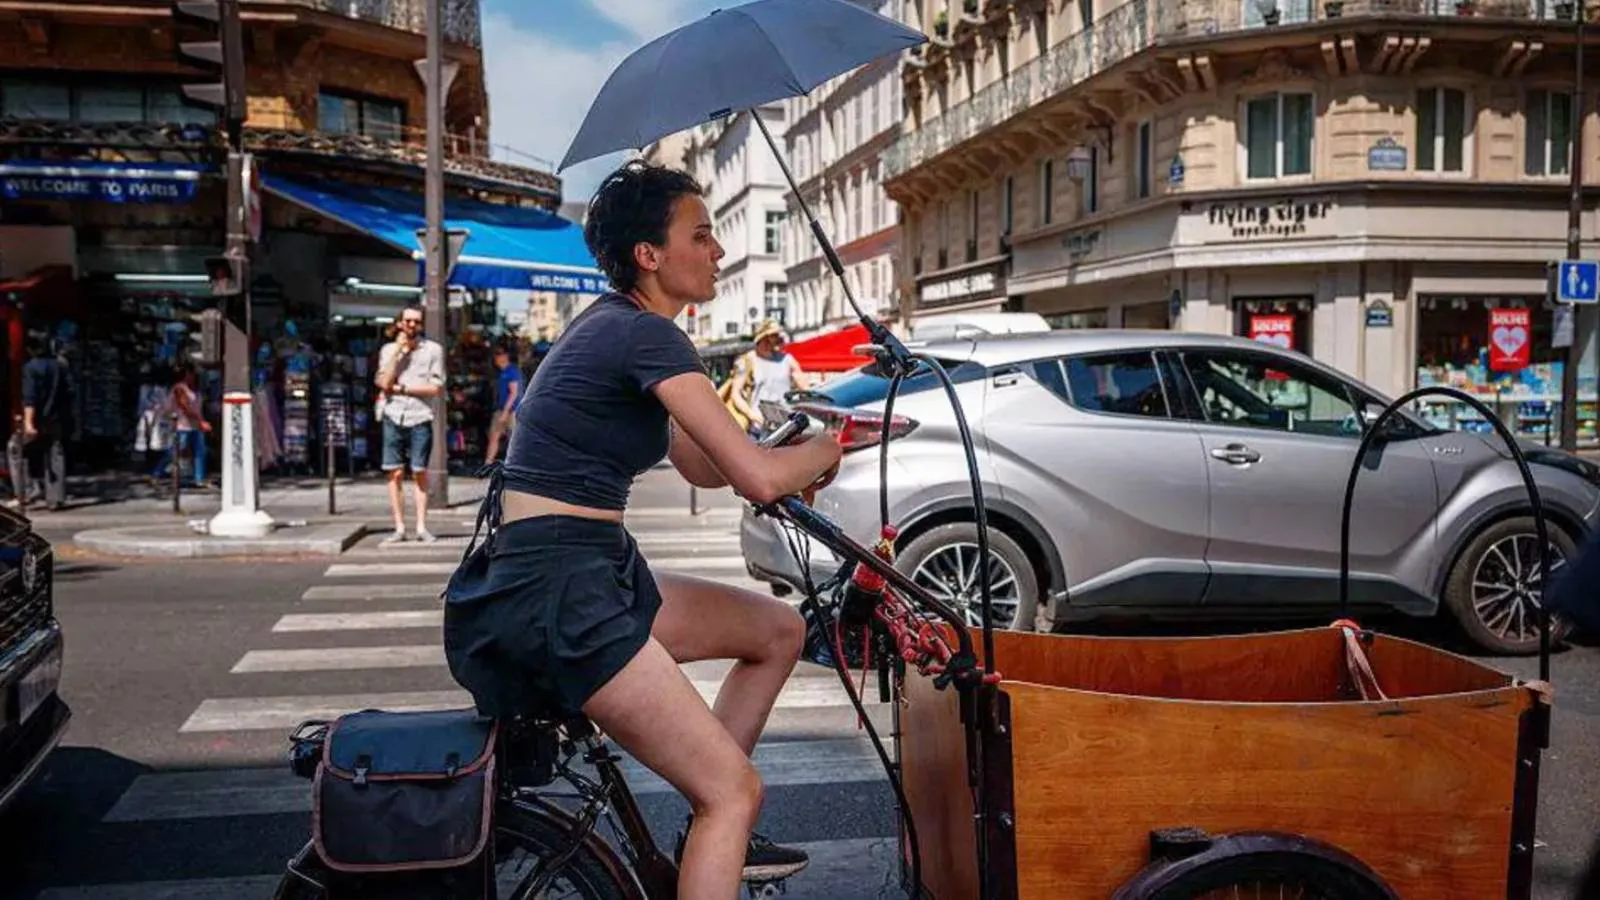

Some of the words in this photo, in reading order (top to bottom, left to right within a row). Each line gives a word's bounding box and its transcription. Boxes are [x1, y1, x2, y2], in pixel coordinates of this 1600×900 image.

[5, 178, 90, 194] WELCOME
[101, 181, 122, 196] TO
[128, 182, 179, 197] PARIS
[1209, 203, 1270, 227] flying
[531, 275, 580, 291] WELCOME
